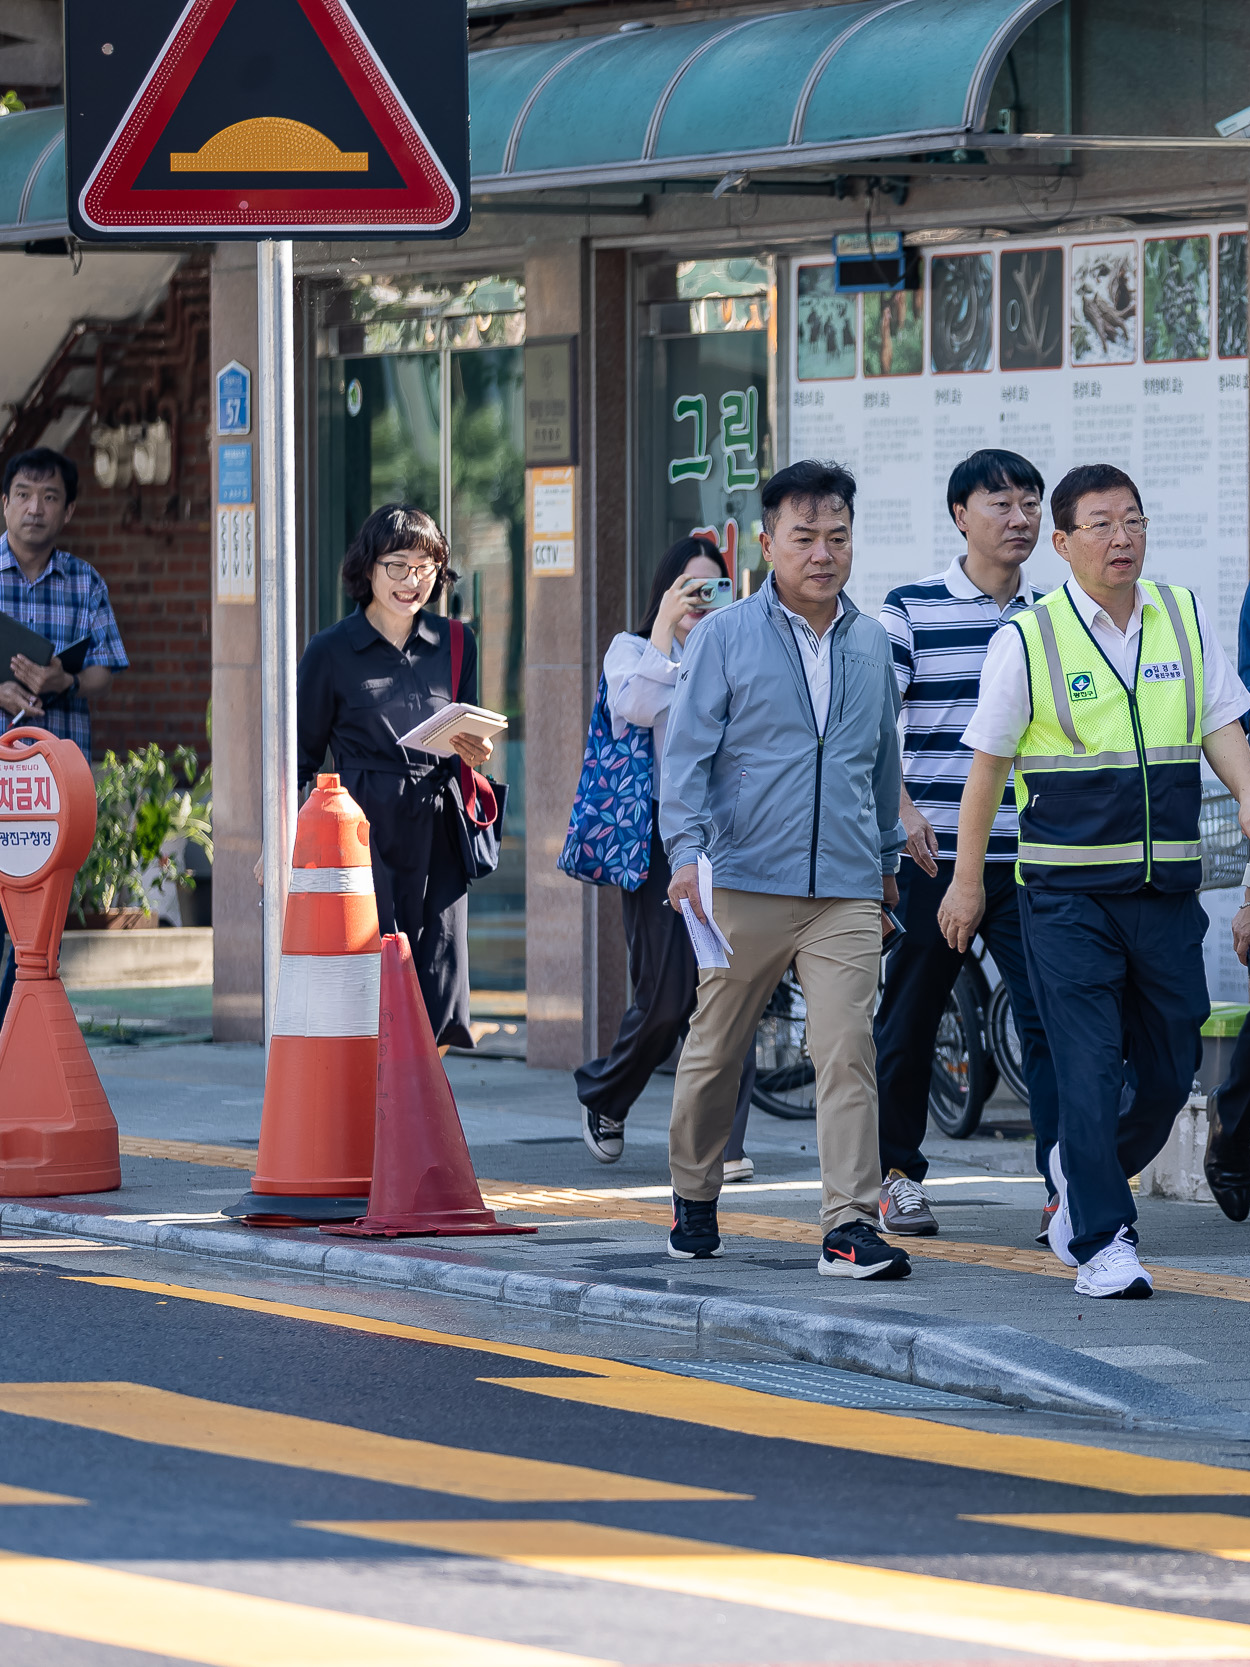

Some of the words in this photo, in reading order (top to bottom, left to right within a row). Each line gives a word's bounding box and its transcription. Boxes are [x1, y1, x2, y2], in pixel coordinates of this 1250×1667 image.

[225, 398, 241, 427] 57
[668, 386, 760, 493] 그린
[535, 544, 559, 565] CCTV
[16, 763, 40, 771] 드립니다
[0, 831, 52, 847] 광진구청장
